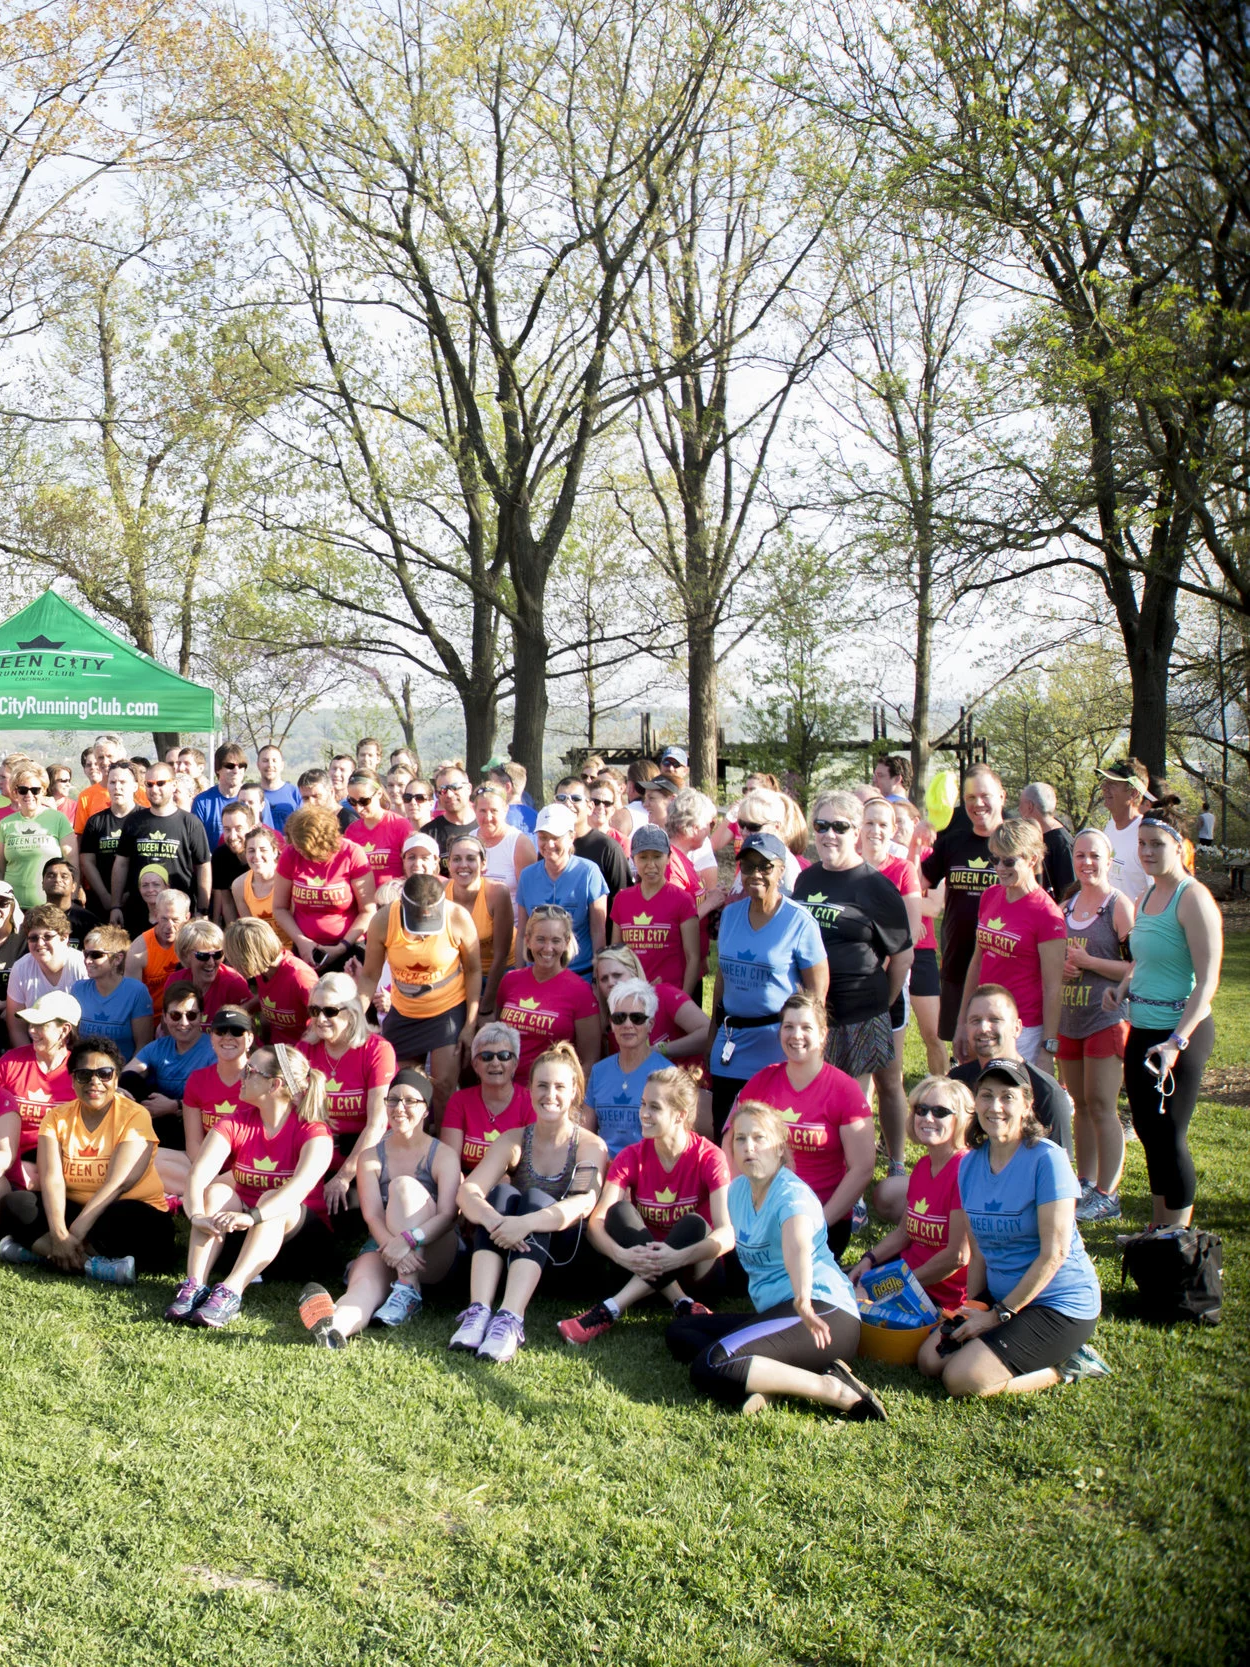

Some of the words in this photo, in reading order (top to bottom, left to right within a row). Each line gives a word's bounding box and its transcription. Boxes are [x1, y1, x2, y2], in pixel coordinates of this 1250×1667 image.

[53, 655, 107, 671] CITY
[47, 669, 75, 677] CLUB
[137, 843, 159, 852] QUEEN
[369, 853, 389, 865] CITY
[950, 871, 979, 885] QUEEN
[292, 887, 319, 900] QUEEN
[322, 887, 345, 900] CITY
[814, 906, 840, 922] CITY
[648, 929, 670, 942] CITY
[995, 935, 1017, 952] CITY
[722, 963, 746, 977] QUEEN
[749, 966, 773, 981] CITY
[1061, 985, 1092, 1006] EPEAT
[529, 1014, 556, 1030] CITY
[337, 1096, 363, 1110] CITY
[793, 1128, 823, 1145] CITY
[234, 1169, 268, 1188] QUEEN
[636, 1202, 670, 1222] QUEEN
[920, 1222, 945, 1240] CITY
[996, 1219, 1022, 1233] CITY
